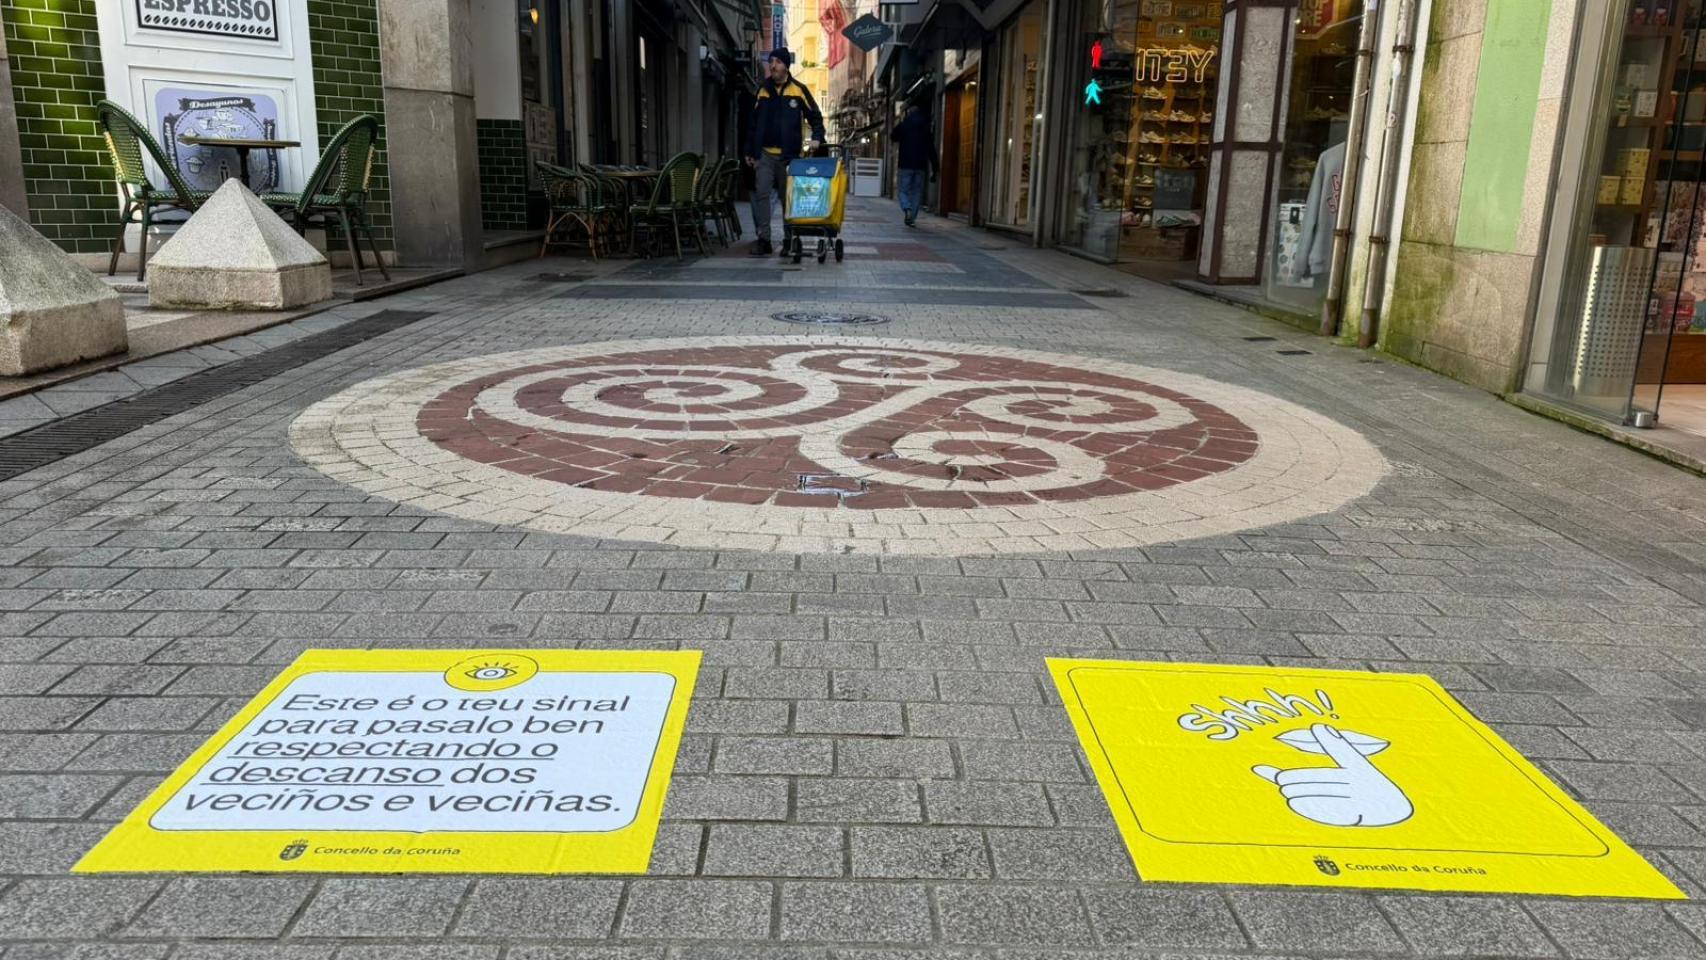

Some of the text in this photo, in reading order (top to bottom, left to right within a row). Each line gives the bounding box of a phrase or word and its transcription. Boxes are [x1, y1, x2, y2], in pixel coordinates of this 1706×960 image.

[189, 98, 244, 109] Desayunos
[282, 694, 630, 711] Este é o teu sinal
[1177, 687, 1340, 741] Shhh!
[252, 715, 604, 737] para pasalo ben
[234, 738, 559, 761] respectando o
[208, 761, 537, 784] descanso dos
[185, 787, 620, 812] veciños e veciñas.
[314, 846, 461, 855] Concello da Coruña
[1345, 863, 1487, 875] Concello da Coruña
